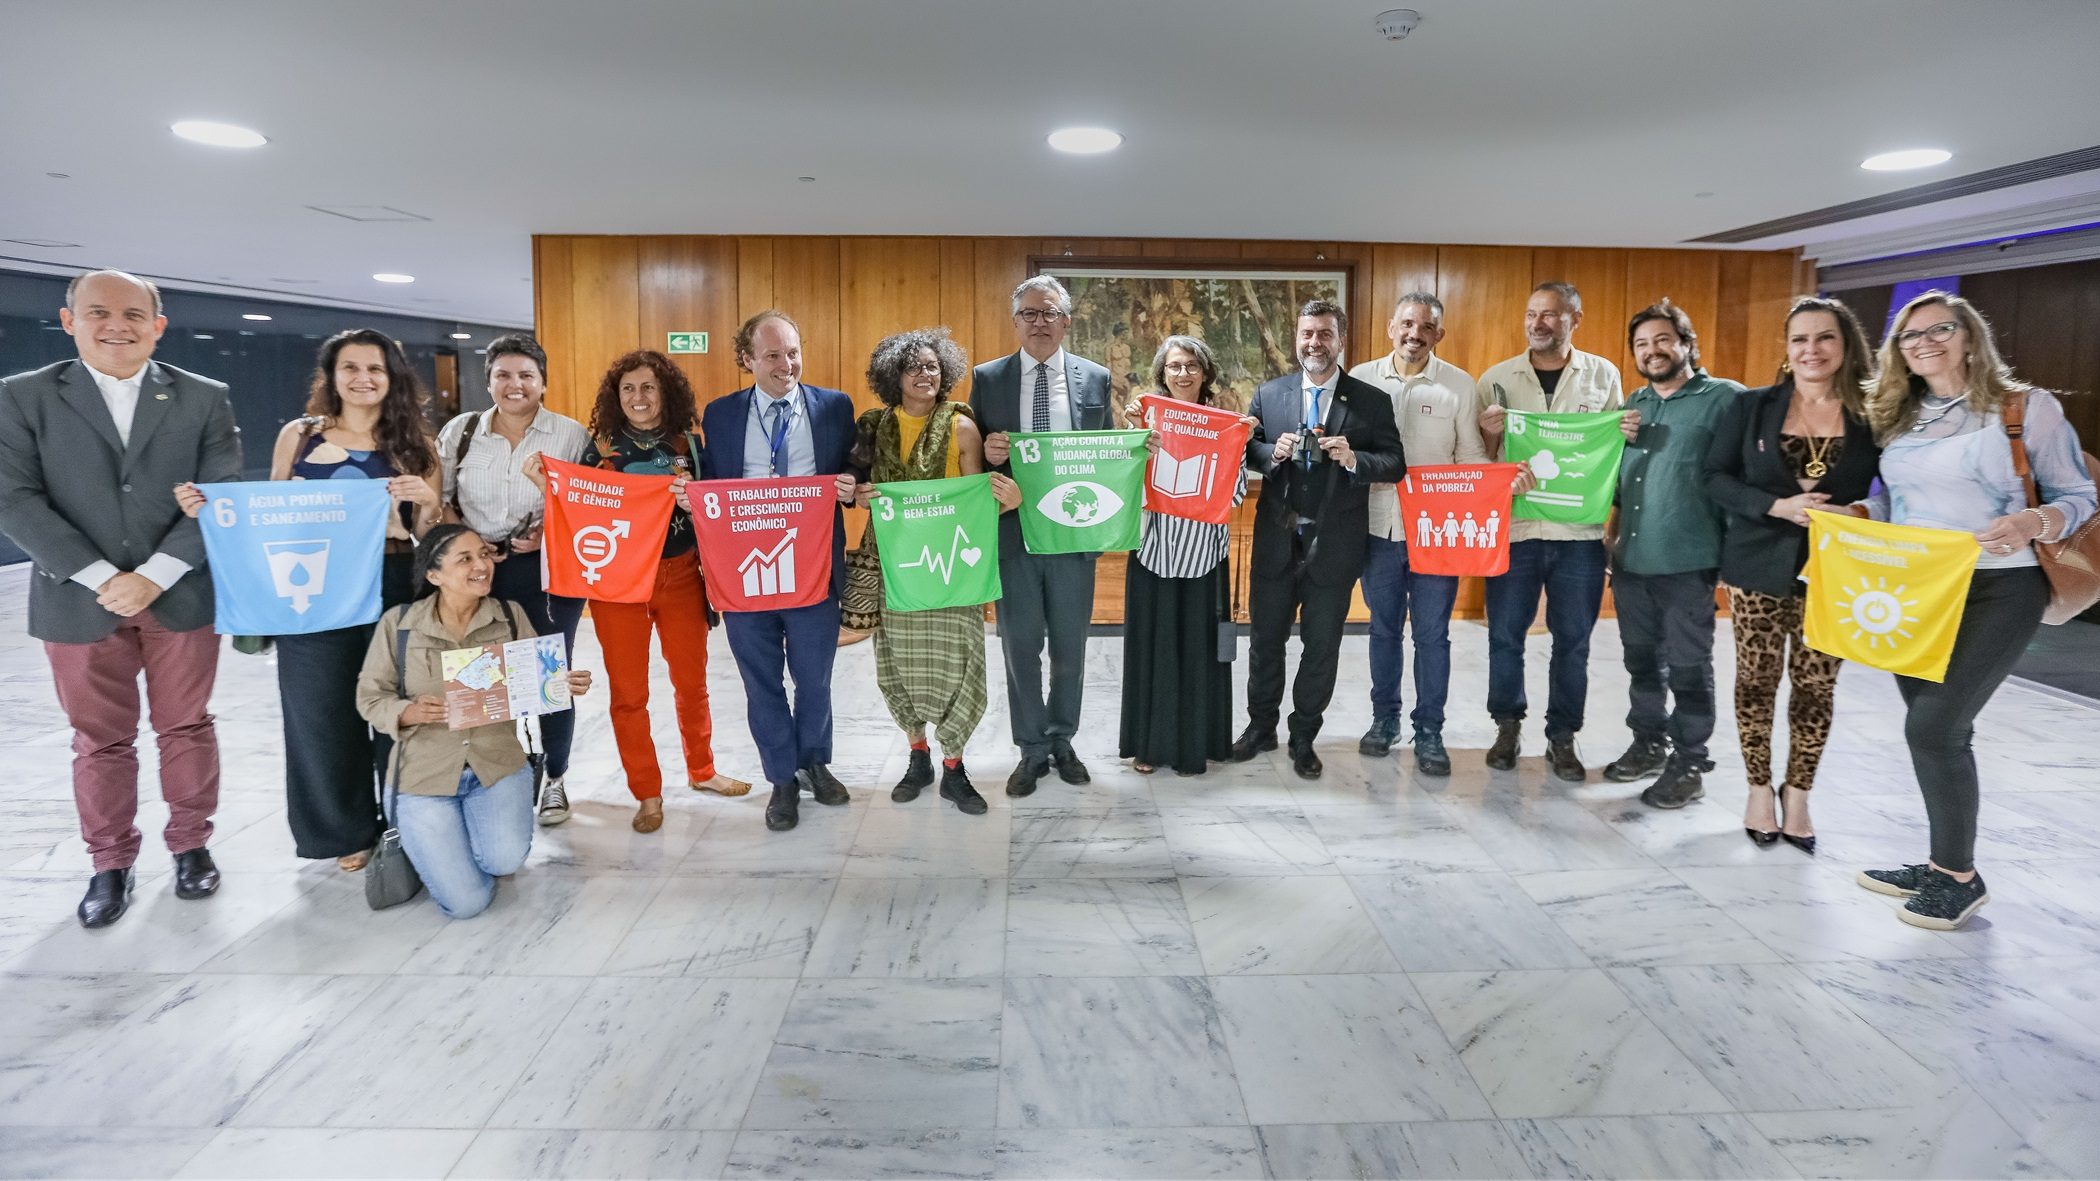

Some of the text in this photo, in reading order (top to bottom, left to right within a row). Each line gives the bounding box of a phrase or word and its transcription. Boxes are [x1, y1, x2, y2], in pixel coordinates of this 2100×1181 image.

[1144, 405, 1156, 429] 4
[1164, 408, 1209, 425] EDUCAÇÃO
[1507, 413, 1527, 435] 15
[1162, 421, 1219, 440] DE QUALIDADE
[1078, 436, 1116, 446] CONTRA
[1116, 436, 1124, 446] A
[1014, 438, 1041, 464] 13
[1053, 449, 1133, 463] MUDANÇA GLOBAL
[1055, 464, 1096, 476] DO CLIMA
[547, 471, 559, 495] 5
[569, 477, 625, 496] IGUALDADE
[1422, 482, 1475, 493] DA POBREZA
[248, 491, 345, 509] ÁGUA POTÁVEL
[567, 491, 621, 509] DE GÊNERO
[727, 486, 822, 502] TRABALHO DECENTE
[902, 493, 942, 505] SAÚDE E
[214, 497, 237, 528] 6
[703, 492, 721, 519] 8
[730, 502, 803, 517] E CRESCIMENTO
[878, 496, 895, 521] 3
[904, 505, 955, 519] BEM-ESTAR
[250, 510, 347, 526] E SANEAMENTO
[731, 517, 787, 532] ECONÔMICO
